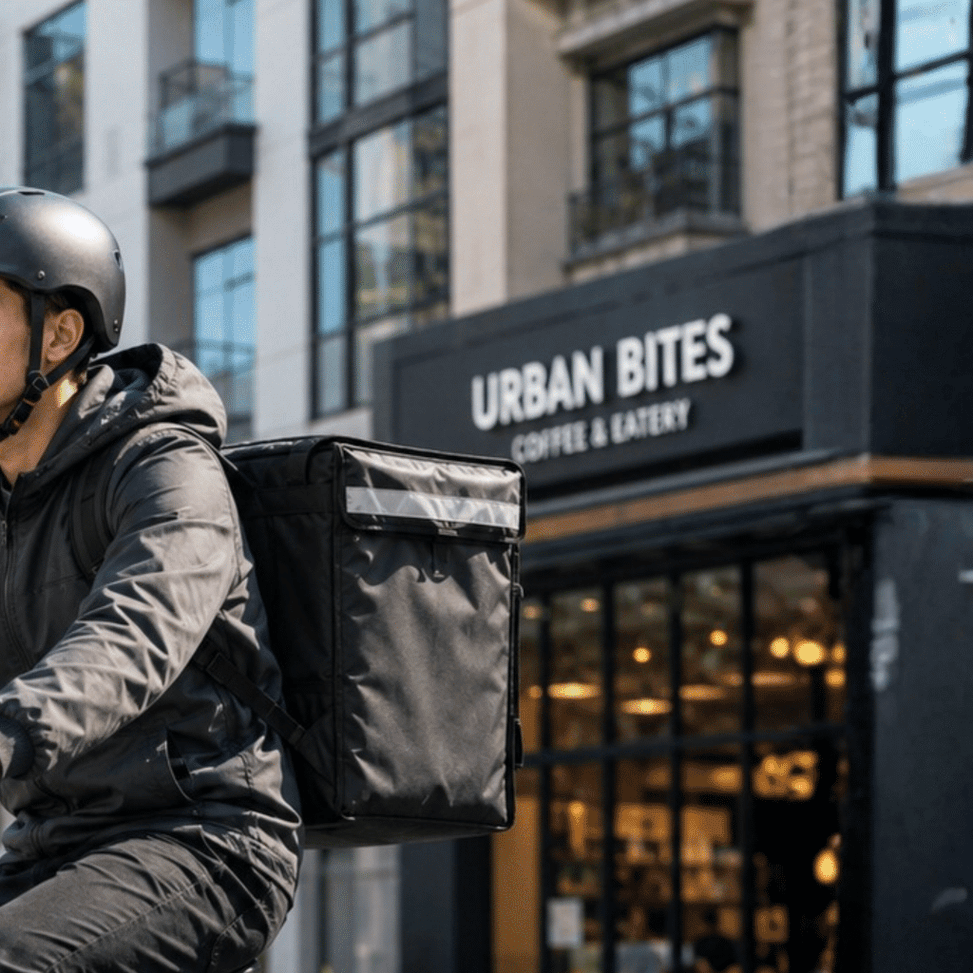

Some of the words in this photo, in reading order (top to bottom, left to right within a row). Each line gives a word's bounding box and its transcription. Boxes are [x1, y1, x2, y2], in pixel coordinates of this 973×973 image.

[472, 345, 604, 430] URBAN
[616, 312, 734, 398] BITES
[511, 420, 588, 465] COFFEE
[590, 416, 607, 448] &
[610, 398, 691, 444] EATERY
